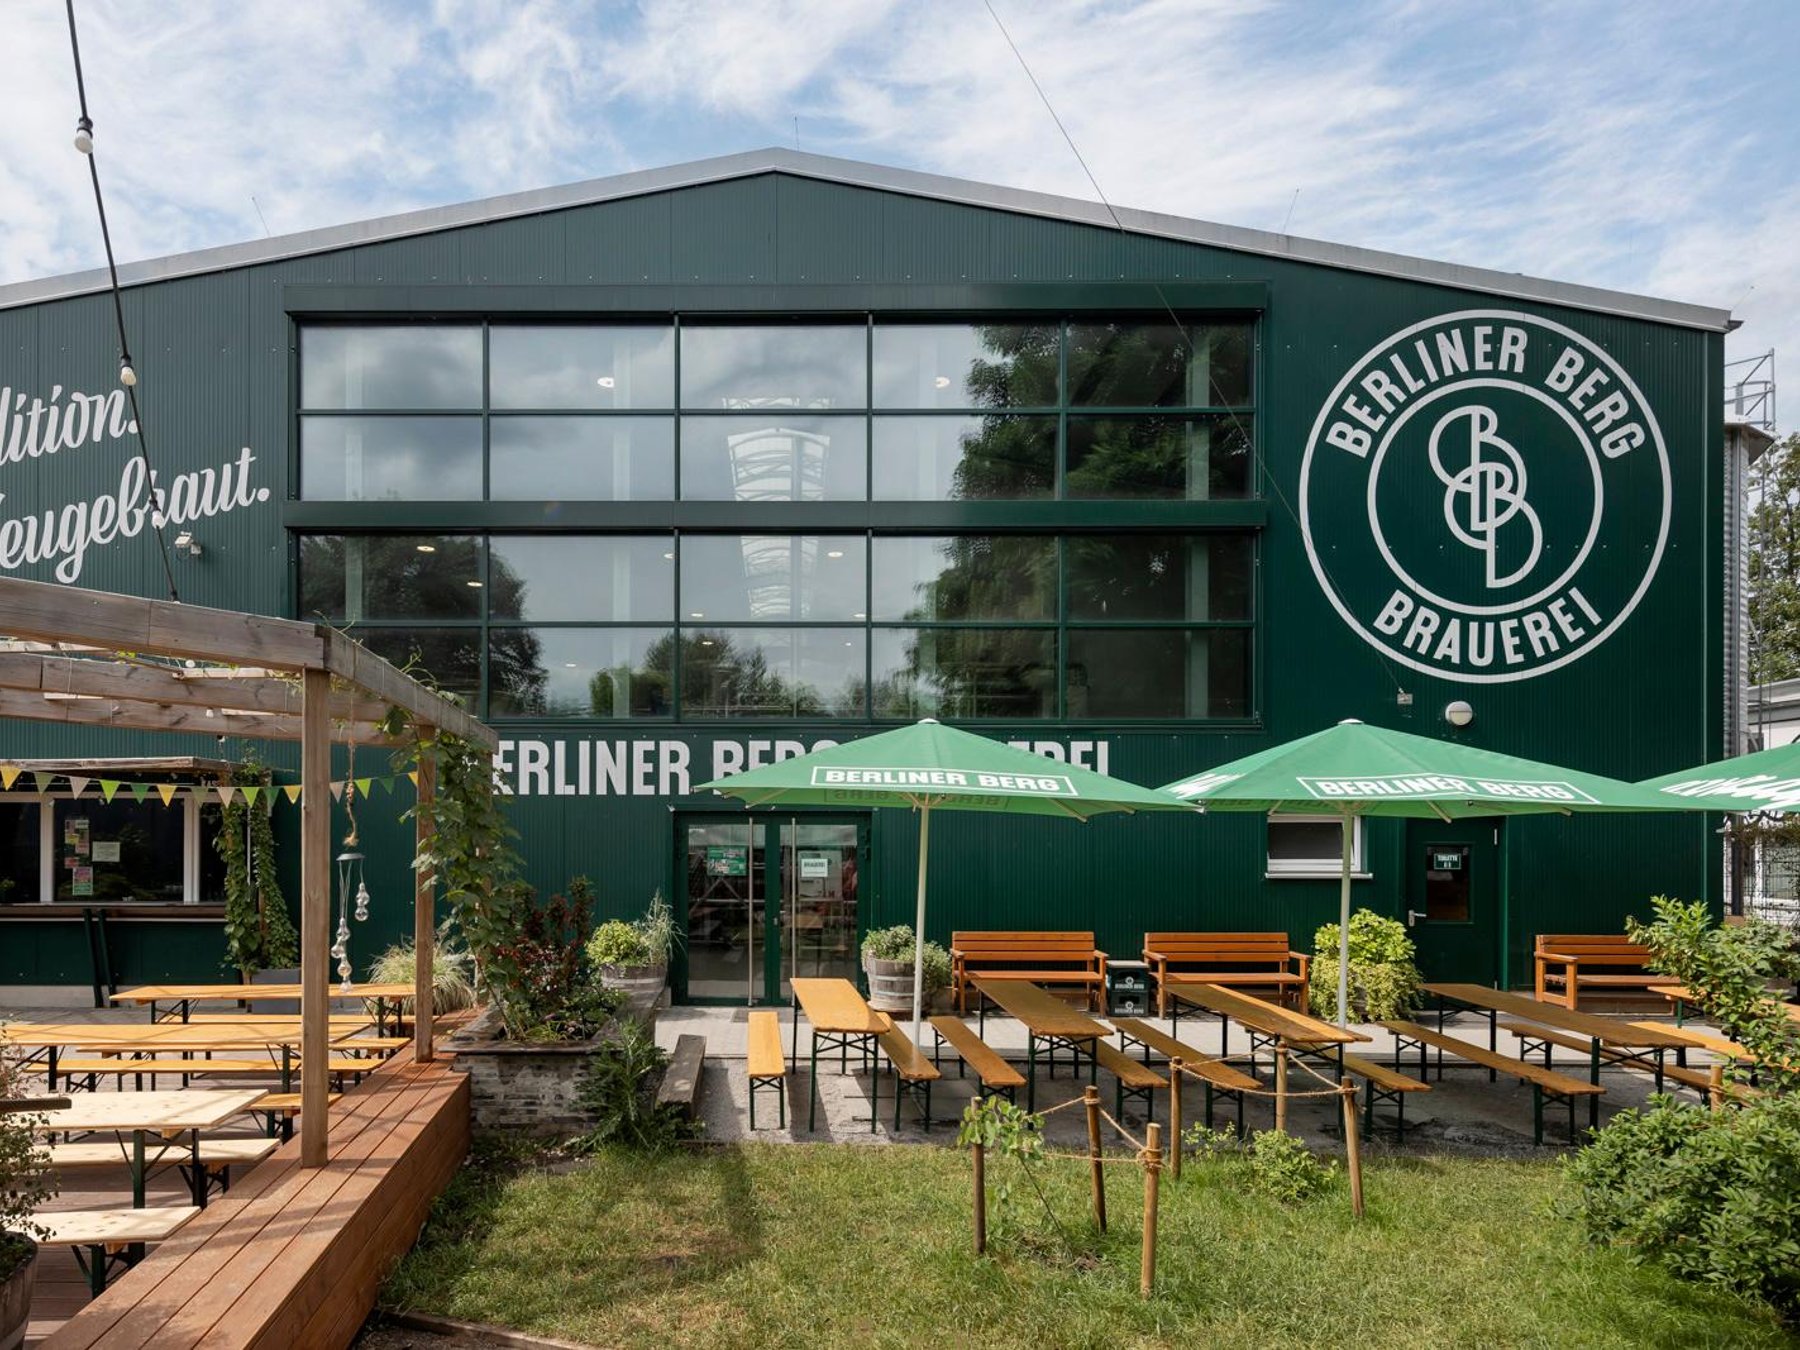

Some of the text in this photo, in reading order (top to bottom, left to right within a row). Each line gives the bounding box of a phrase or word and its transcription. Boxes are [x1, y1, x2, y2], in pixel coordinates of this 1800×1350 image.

[1325, 326, 1645, 459] BERLINER BERG
[0, 447, 270, 584] eugebraut.
[1373, 586, 1602, 667] BRAUEREI
[491, 740, 691, 796] ERLINER
[825, 770, 1060, 791] BERLINER BERG
[1316, 775, 1575, 800] BERLINER BERG
